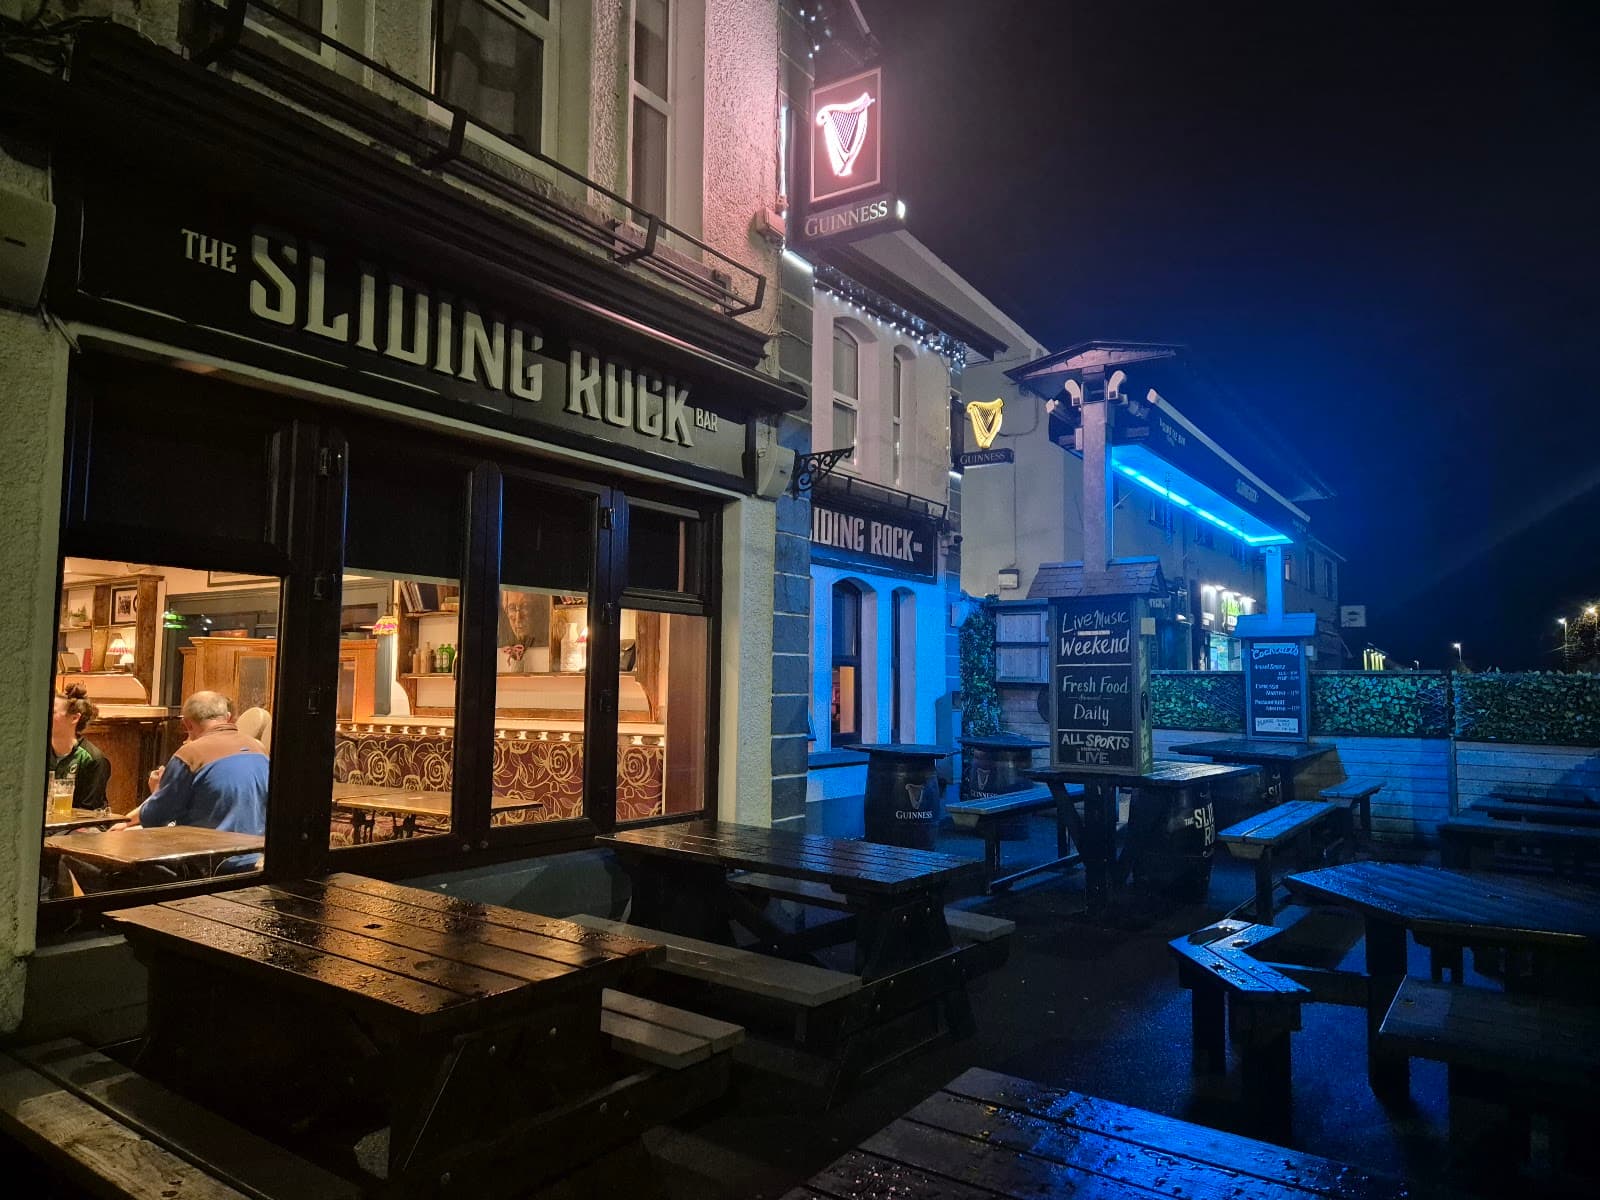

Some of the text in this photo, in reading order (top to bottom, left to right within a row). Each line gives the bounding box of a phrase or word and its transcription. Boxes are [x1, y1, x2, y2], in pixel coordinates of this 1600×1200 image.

[804, 200, 888, 237] GUINNESS
[181, 228, 719, 448] THE SLIDING ROCK BAR
[960, 452, 1006, 465] GUINNESS
[809, 506, 915, 562] IDING ROCK
[1062, 609, 1129, 633] Live Music
[1061, 629, 1130, 656] Weekend
[1062, 675, 1129, 694] Fresh Food
[1073, 703, 1109, 727] Daily
[1061, 733, 1130, 750] ALL SPORTS
[1076, 751, 1110, 764] LIVE
[895, 810, 934, 820] GUINNESS
